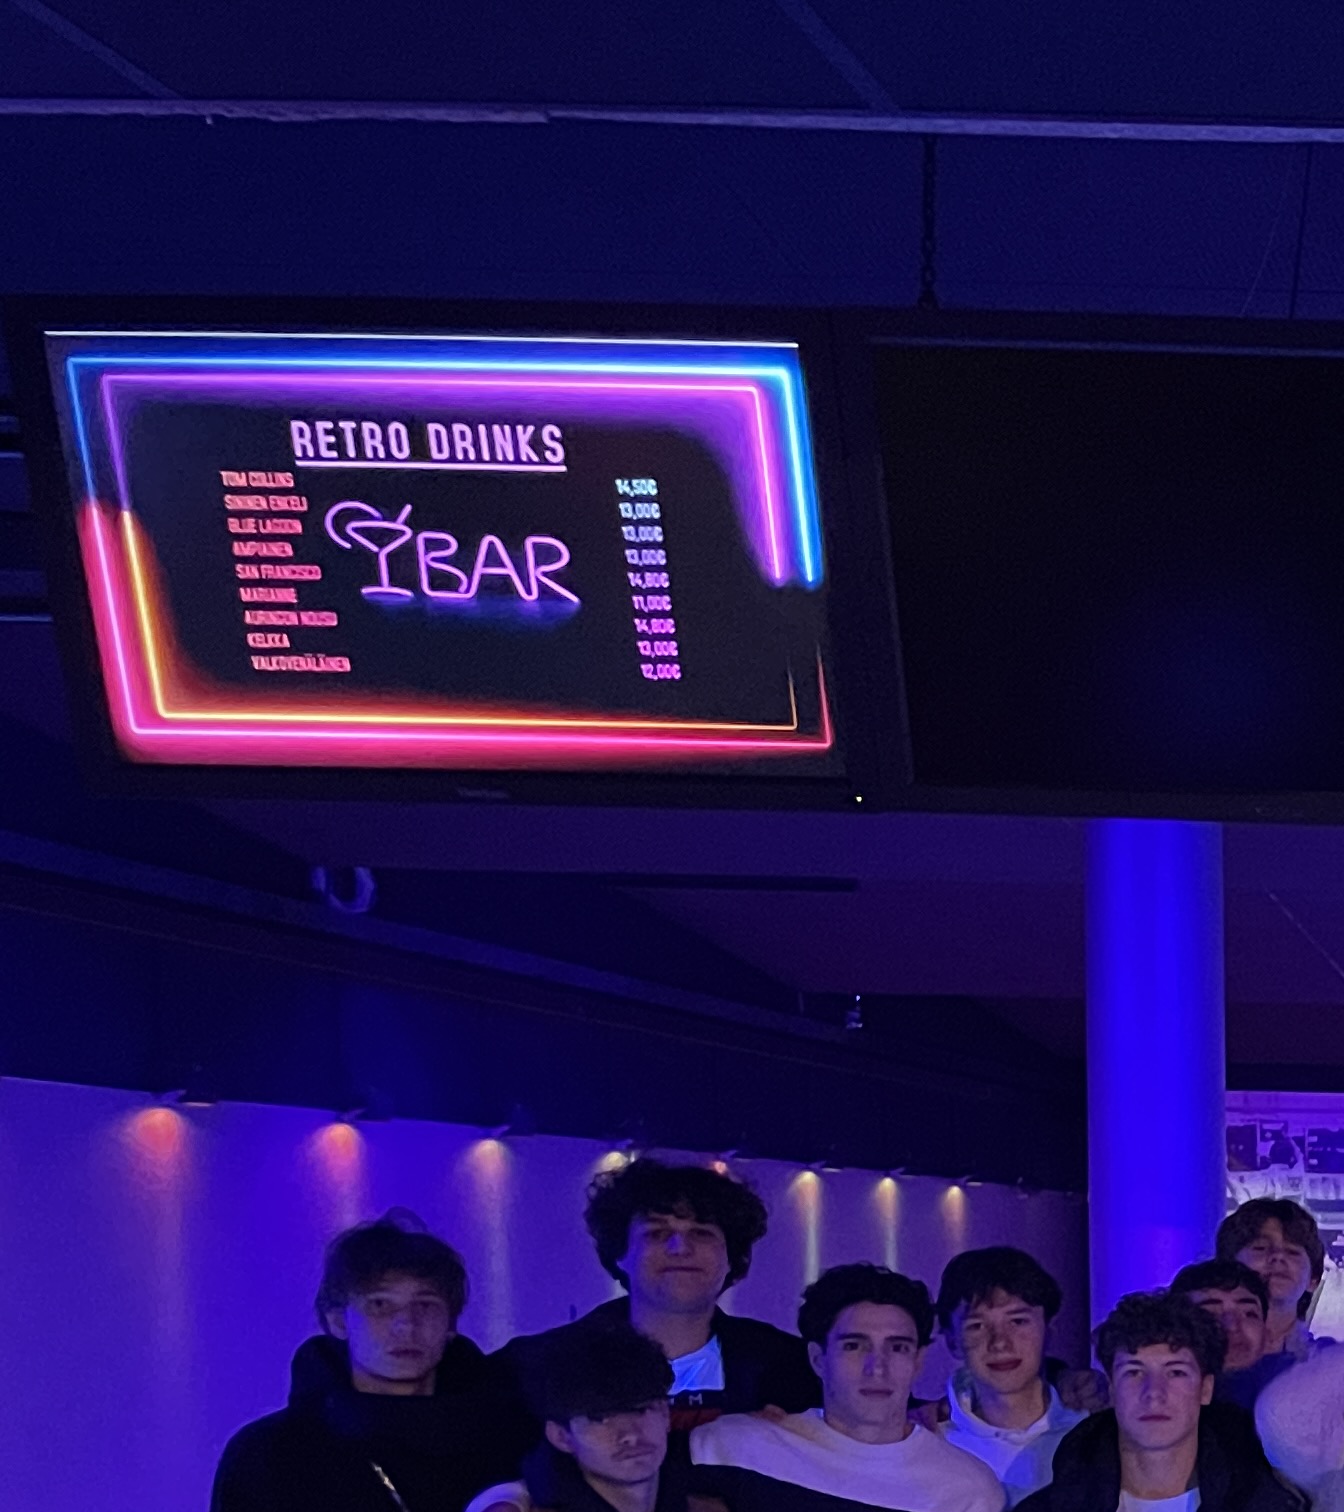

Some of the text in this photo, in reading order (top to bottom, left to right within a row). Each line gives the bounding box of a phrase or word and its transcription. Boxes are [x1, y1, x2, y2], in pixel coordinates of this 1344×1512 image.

[291, 420, 566, 464] RETRO DRINKS
[416, 532, 581, 605] BAR
